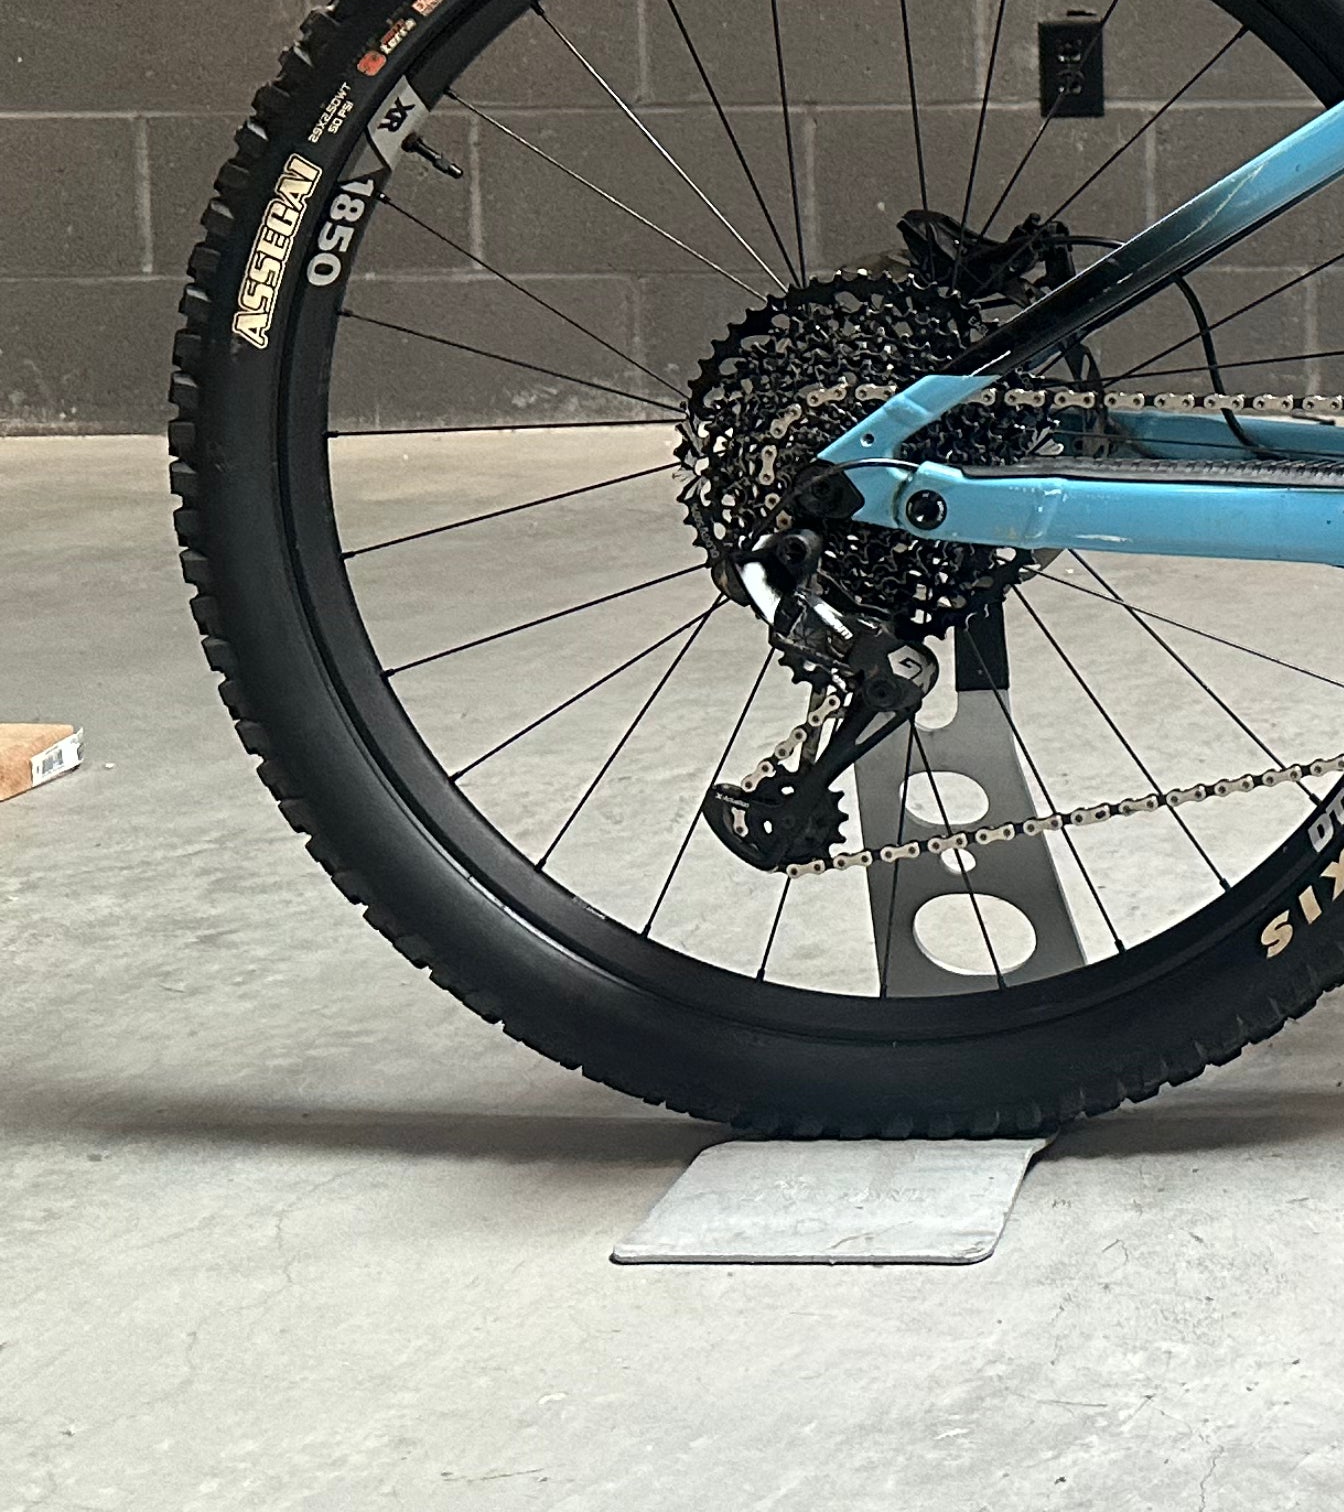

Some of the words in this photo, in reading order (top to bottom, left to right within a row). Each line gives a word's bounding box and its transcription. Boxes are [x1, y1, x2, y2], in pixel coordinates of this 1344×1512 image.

[336, 99, 355, 120] PSI
[376, 96, 417, 133] XR
[232, 153, 323, 350] ASSEGAI
[306, 177, 375, 287] 1850
